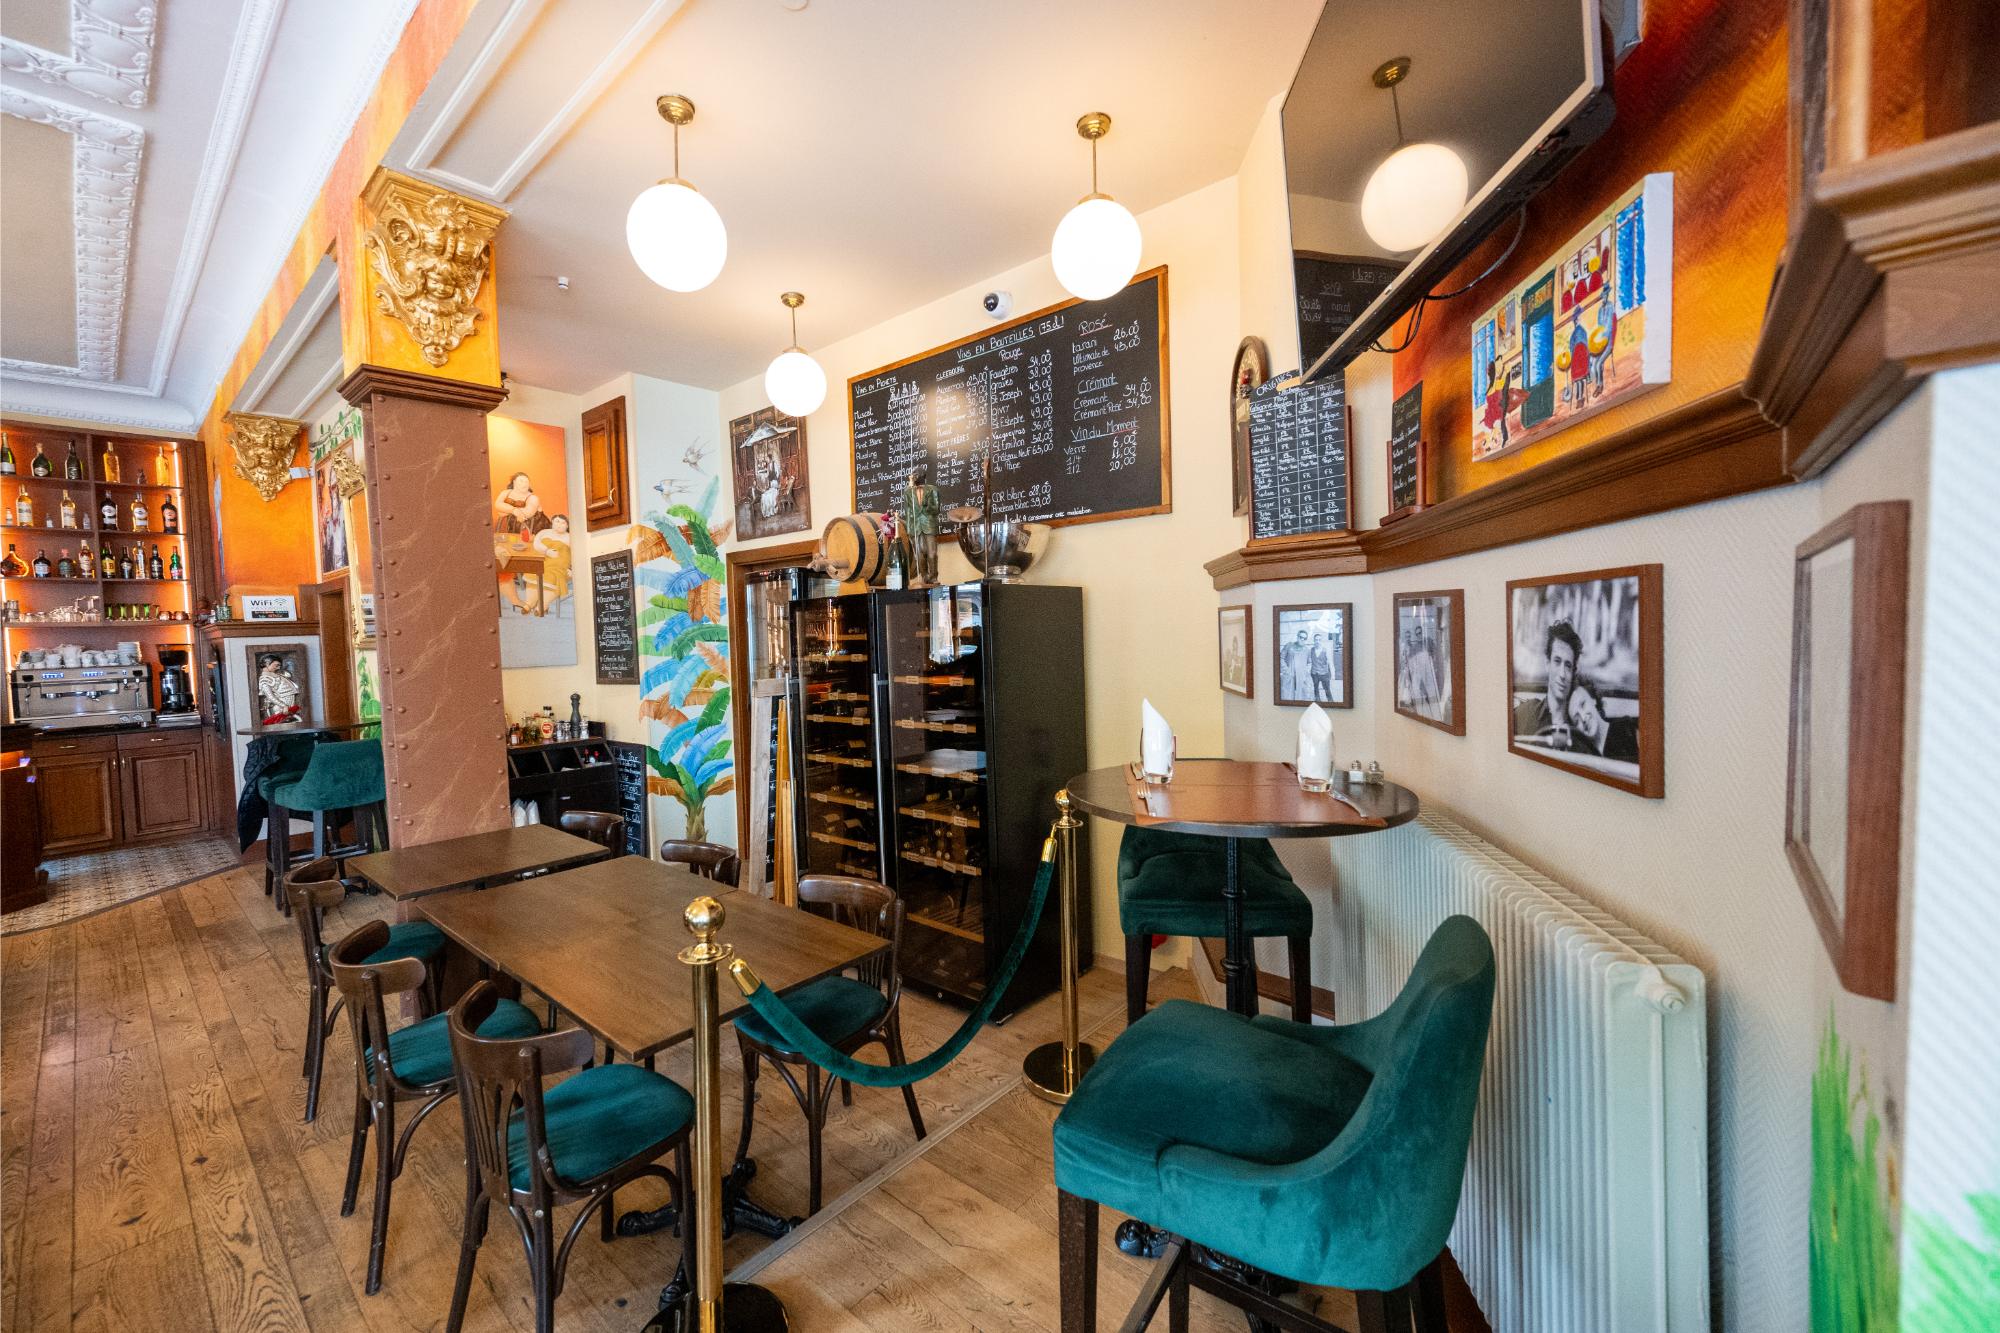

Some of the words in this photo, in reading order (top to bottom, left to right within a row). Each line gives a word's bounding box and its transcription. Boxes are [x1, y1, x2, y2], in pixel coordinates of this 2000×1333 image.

[976, 344, 984, 354] EN
[999, 348, 1022, 360] Rouge
[1102, 346, 1110, 357] de
[1074, 361, 1104, 376] provence
[1078, 372, 1116, 392] Crémant
[1074, 392, 1108, 410] Crémant
[1074, 406, 1106, 421] Crémant
[1090, 426, 1100, 436] du
[994, 463, 1002, 472] du
[1006, 486, 1026, 500] blanc
